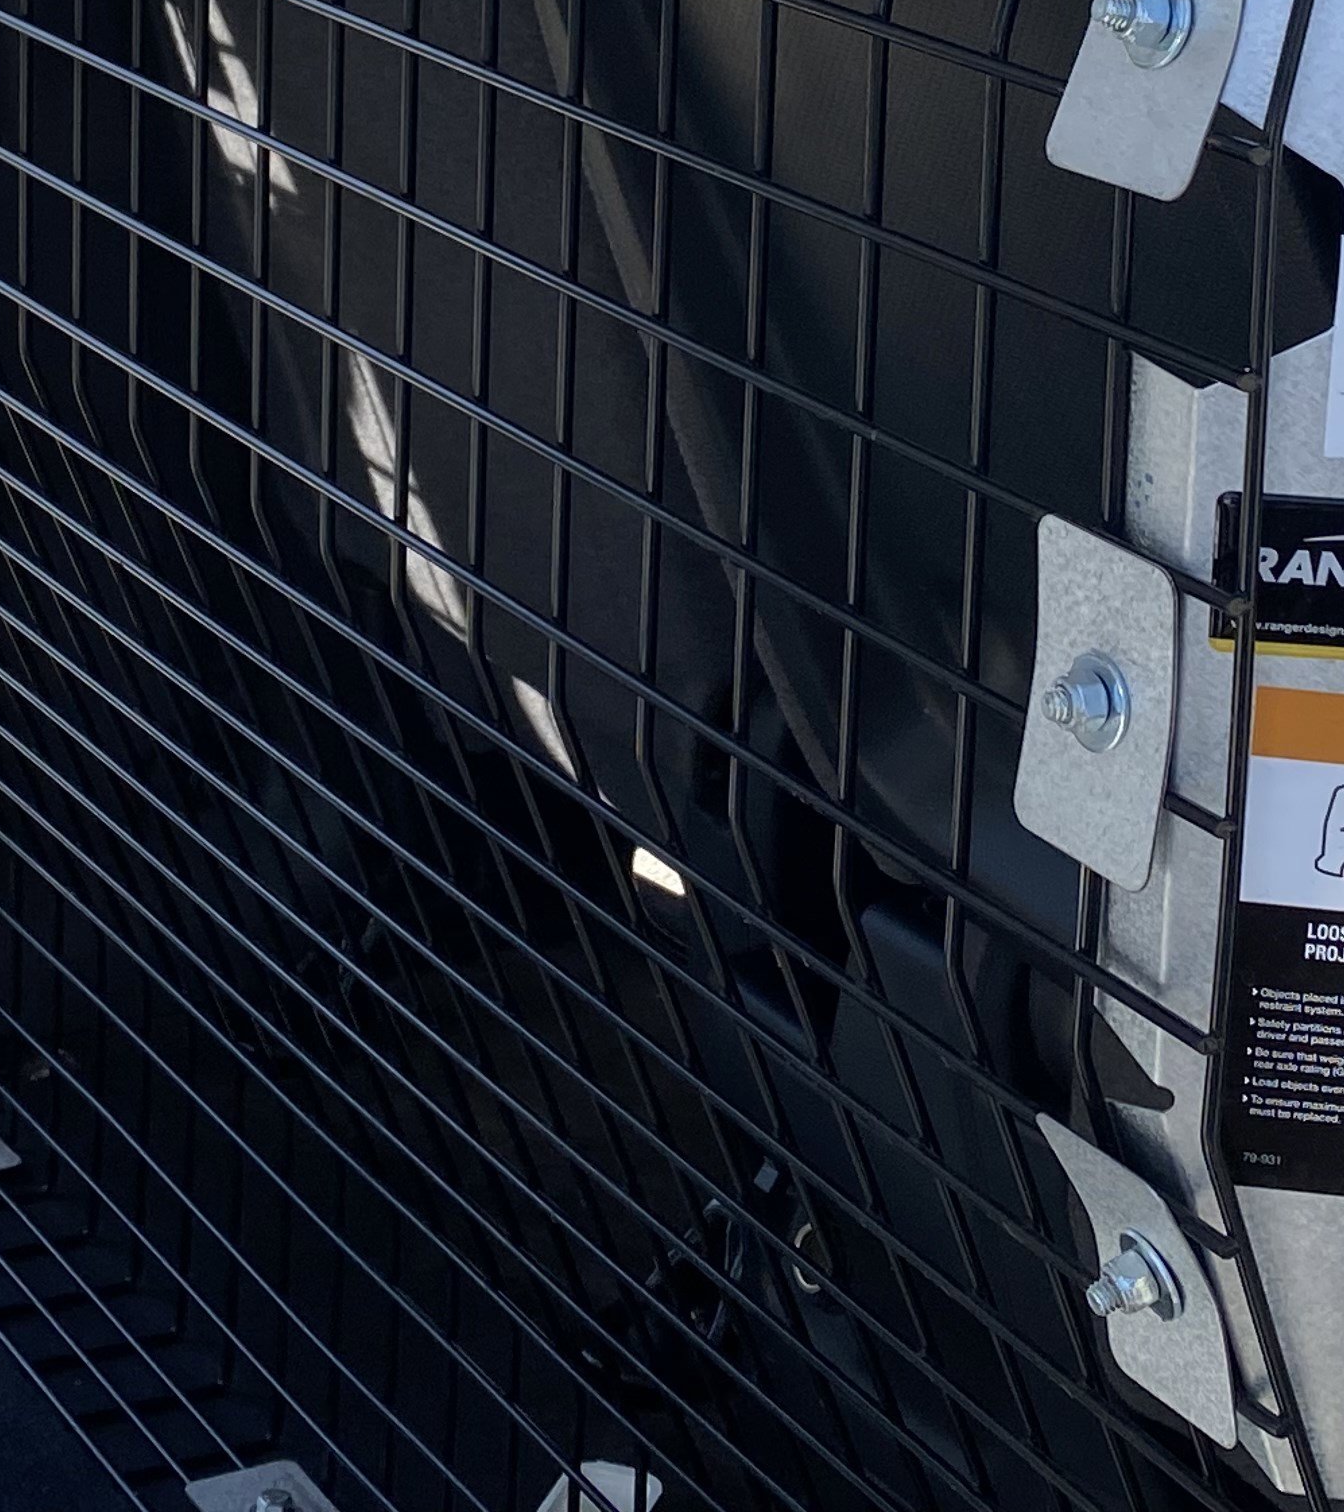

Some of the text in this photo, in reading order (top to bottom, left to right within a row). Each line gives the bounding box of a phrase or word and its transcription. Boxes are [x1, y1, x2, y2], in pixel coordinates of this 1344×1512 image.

[1260, 988, 1301, 1000] Objects
[1302, 993, 1338, 1004] placed
[1258, 1017, 1291, 1031] Safety
[1293, 1023, 1342, 1034] partitions
[1256, 1030, 1286, 1040] driver
[1288, 1034, 1308, 1043] and
[1255, 1047, 1270, 1057] Be
[1272, 1050, 1295, 1059] sure
[1297, 1052, 1317, 1062] that
[1254, 1060, 1274, 1069] rear
[1300, 1064, 1330, 1077] rating
[1252, 1076, 1279, 1088] Load
[1280, 1080, 1320, 1092] objects
[1250, 1094, 1263, 1104] To
[1265, 1098, 1300, 1108] ensure
[1249, 1108, 1276, 1117] must
[1277, 1109, 1291, 1119] be
